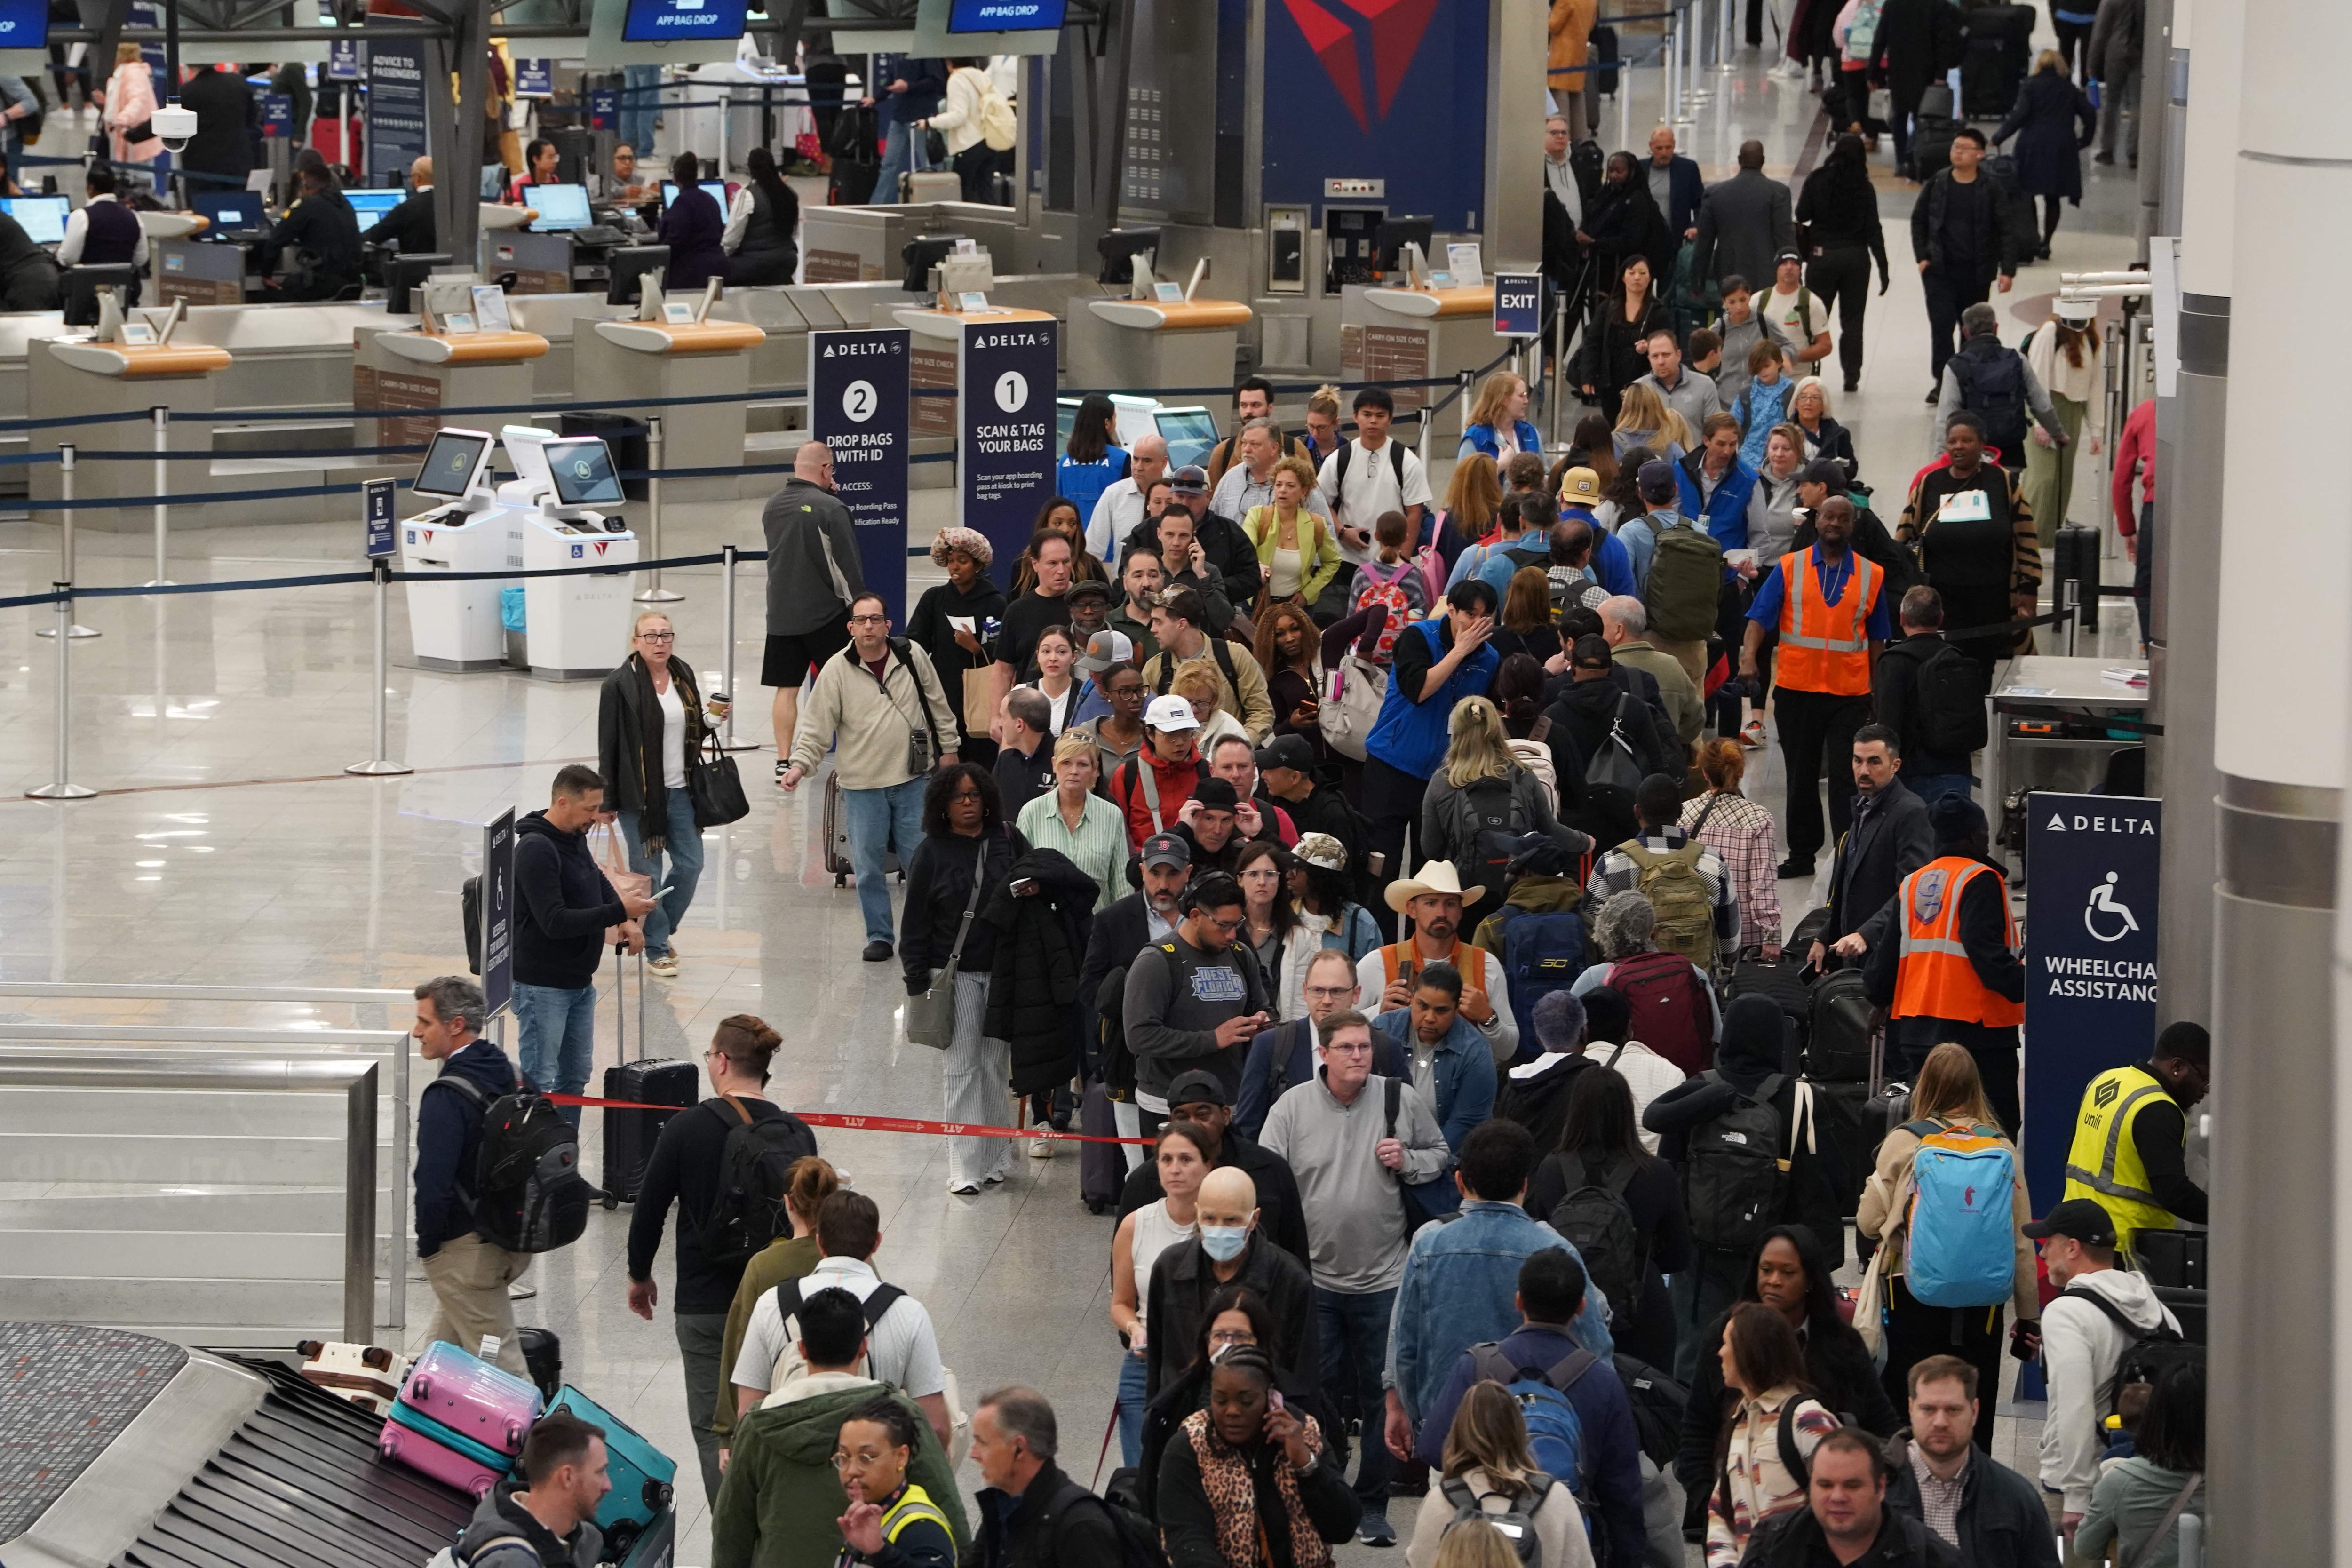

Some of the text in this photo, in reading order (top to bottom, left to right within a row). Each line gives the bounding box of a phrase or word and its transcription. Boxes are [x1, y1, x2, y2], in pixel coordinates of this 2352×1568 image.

[979, 5, 1039, 17] APP BAG DROP
[656, 14, 718, 25] APP BAG DROP
[0, 21, 16, 32] OP
[373, 55, 415, 68] ADVICE TO
[373, 66, 421, 80] PASSENGERS
[1501, 294, 1536, 309] EXIT
[990, 334, 1036, 347] DELTA
[839, 343, 887, 356] DELTA
[1007, 380, 1015, 404] 1
[853, 389, 867, 414] 2
[977, 423, 1045, 438] SCAN & TAG
[826, 433, 893, 447] DROP BAGS
[978, 438, 1044, 453] YOUR BAGS
[835, 449, 883, 462] WITH ID
[842, 482, 873, 491] ACCESS:
[856, 503, 882, 511] Boarding
[882, 517, 900, 525] Ready
[2074, 815, 2155, 835] DELTA
[495, 828, 506, 845] DELTA
[2045, 955, 2158, 980] WHEELCHA
[1200, 969, 1232, 981] WEST
[1194, 976, 1243, 994] FLORIDA
[2049, 979, 2158, 1002] ASSISTANC
[842, 1116, 866, 1127] ATL
[2084, 1113, 2102, 1130] unifi
[941, 1124, 965, 1134] ATL
